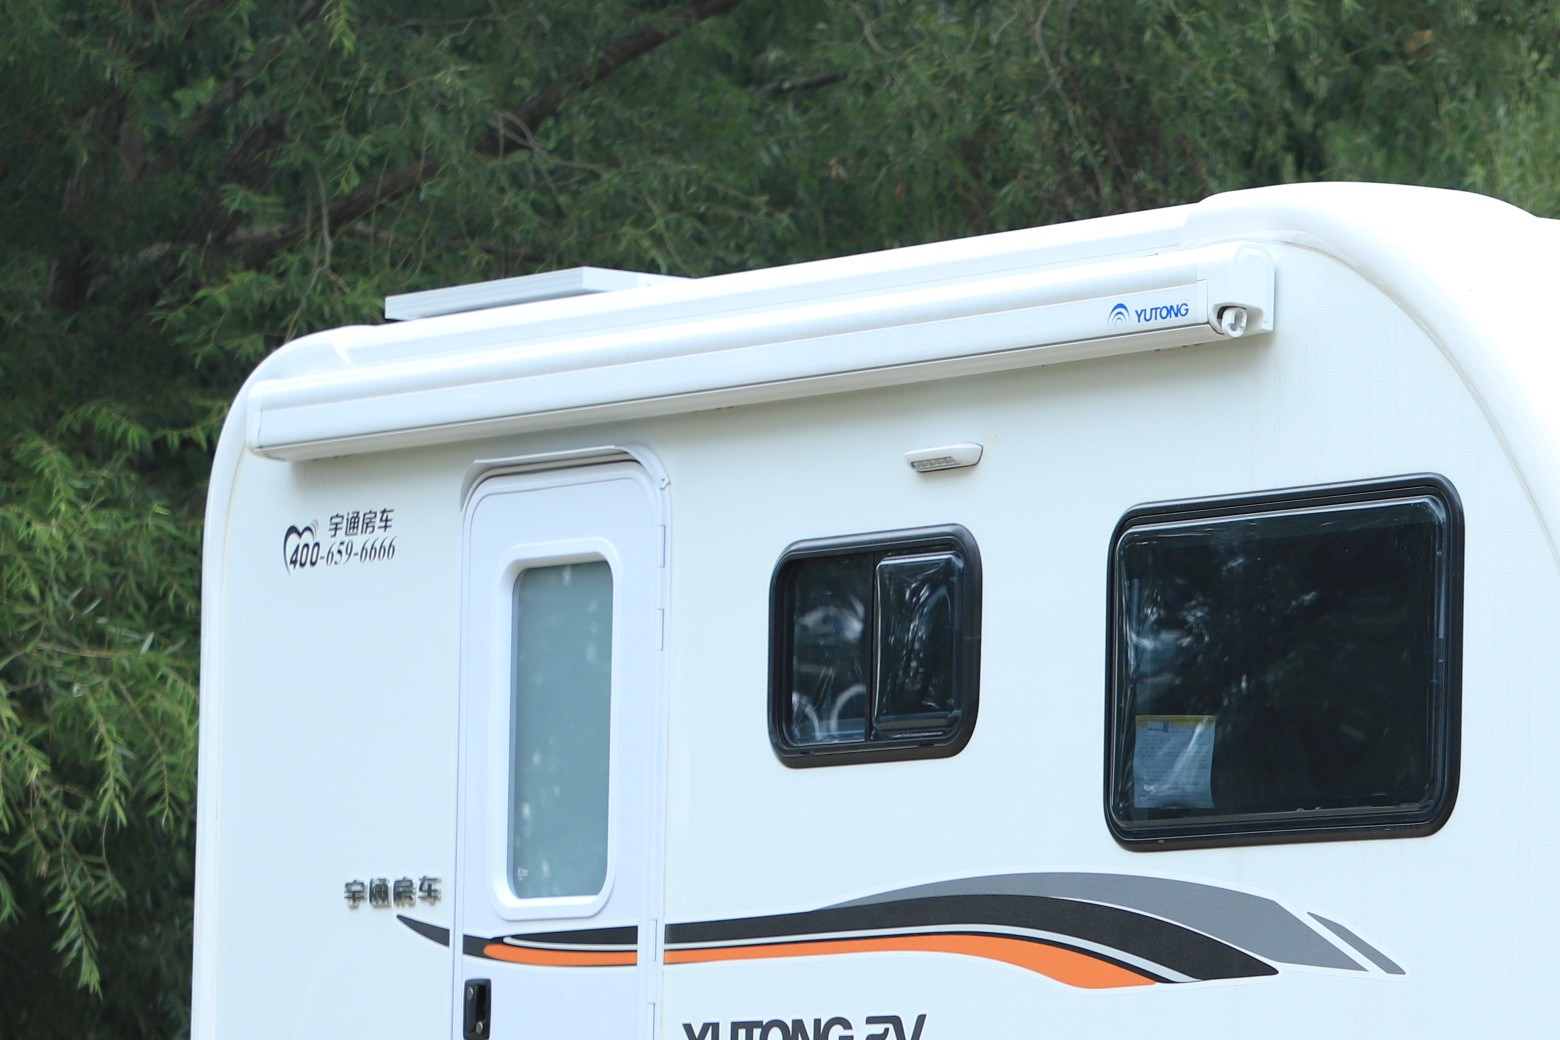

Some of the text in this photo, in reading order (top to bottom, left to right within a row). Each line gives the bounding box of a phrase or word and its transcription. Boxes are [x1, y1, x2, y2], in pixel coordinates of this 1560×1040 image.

[1135, 303, 1190, 323] YUTONG
[328, 508, 395, 538] 宇通房车
[288, 536, 398, 570] 400-659-6666
[344, 875, 442, 909] 宇通房车
